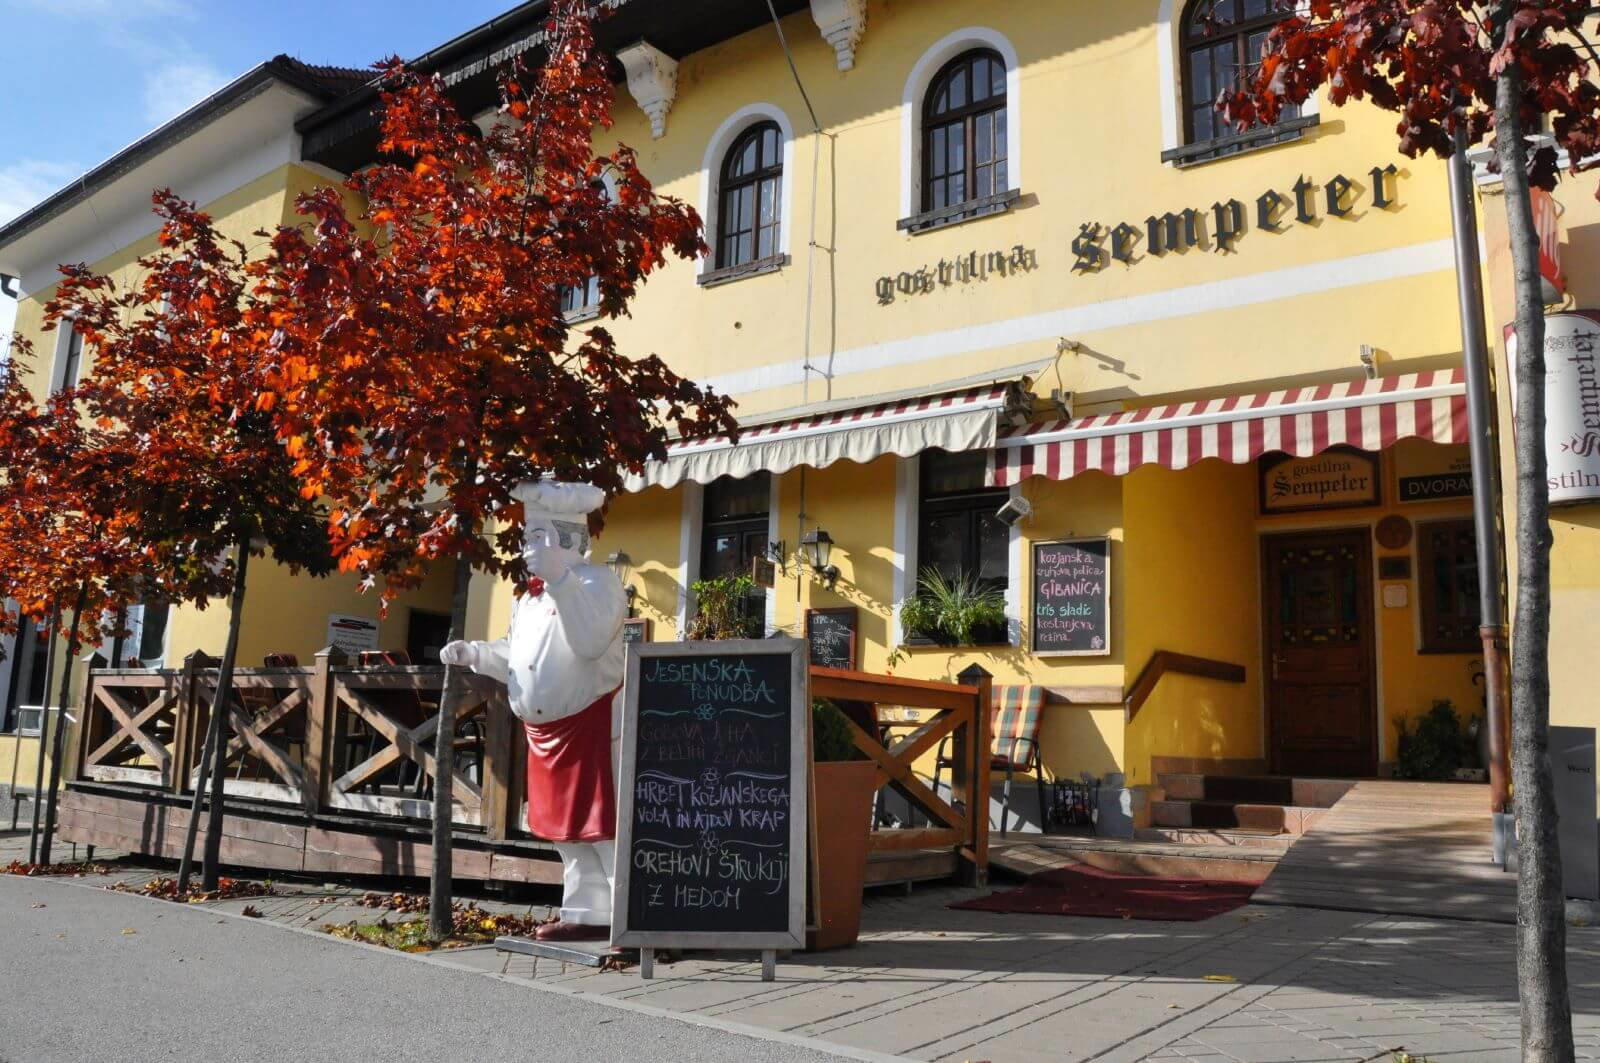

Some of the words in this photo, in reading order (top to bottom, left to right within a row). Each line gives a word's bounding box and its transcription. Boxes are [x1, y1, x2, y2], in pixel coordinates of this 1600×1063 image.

[1292, 459, 1351, 478] gostilna
[1547, 469, 1600, 490] stiln
[1272, 471, 1369, 499] Šempeter
[1408, 478, 1473, 496] DVORA
[645, 659, 755, 682] JESENSKA
[688, 679, 777, 705] PONUDBA
[635, 780, 684, 808] HRBET
[638, 806, 671, 829] VOLA
[739, 808, 786, 831] KRAP
[673, 883, 741, 910] MEDOM
